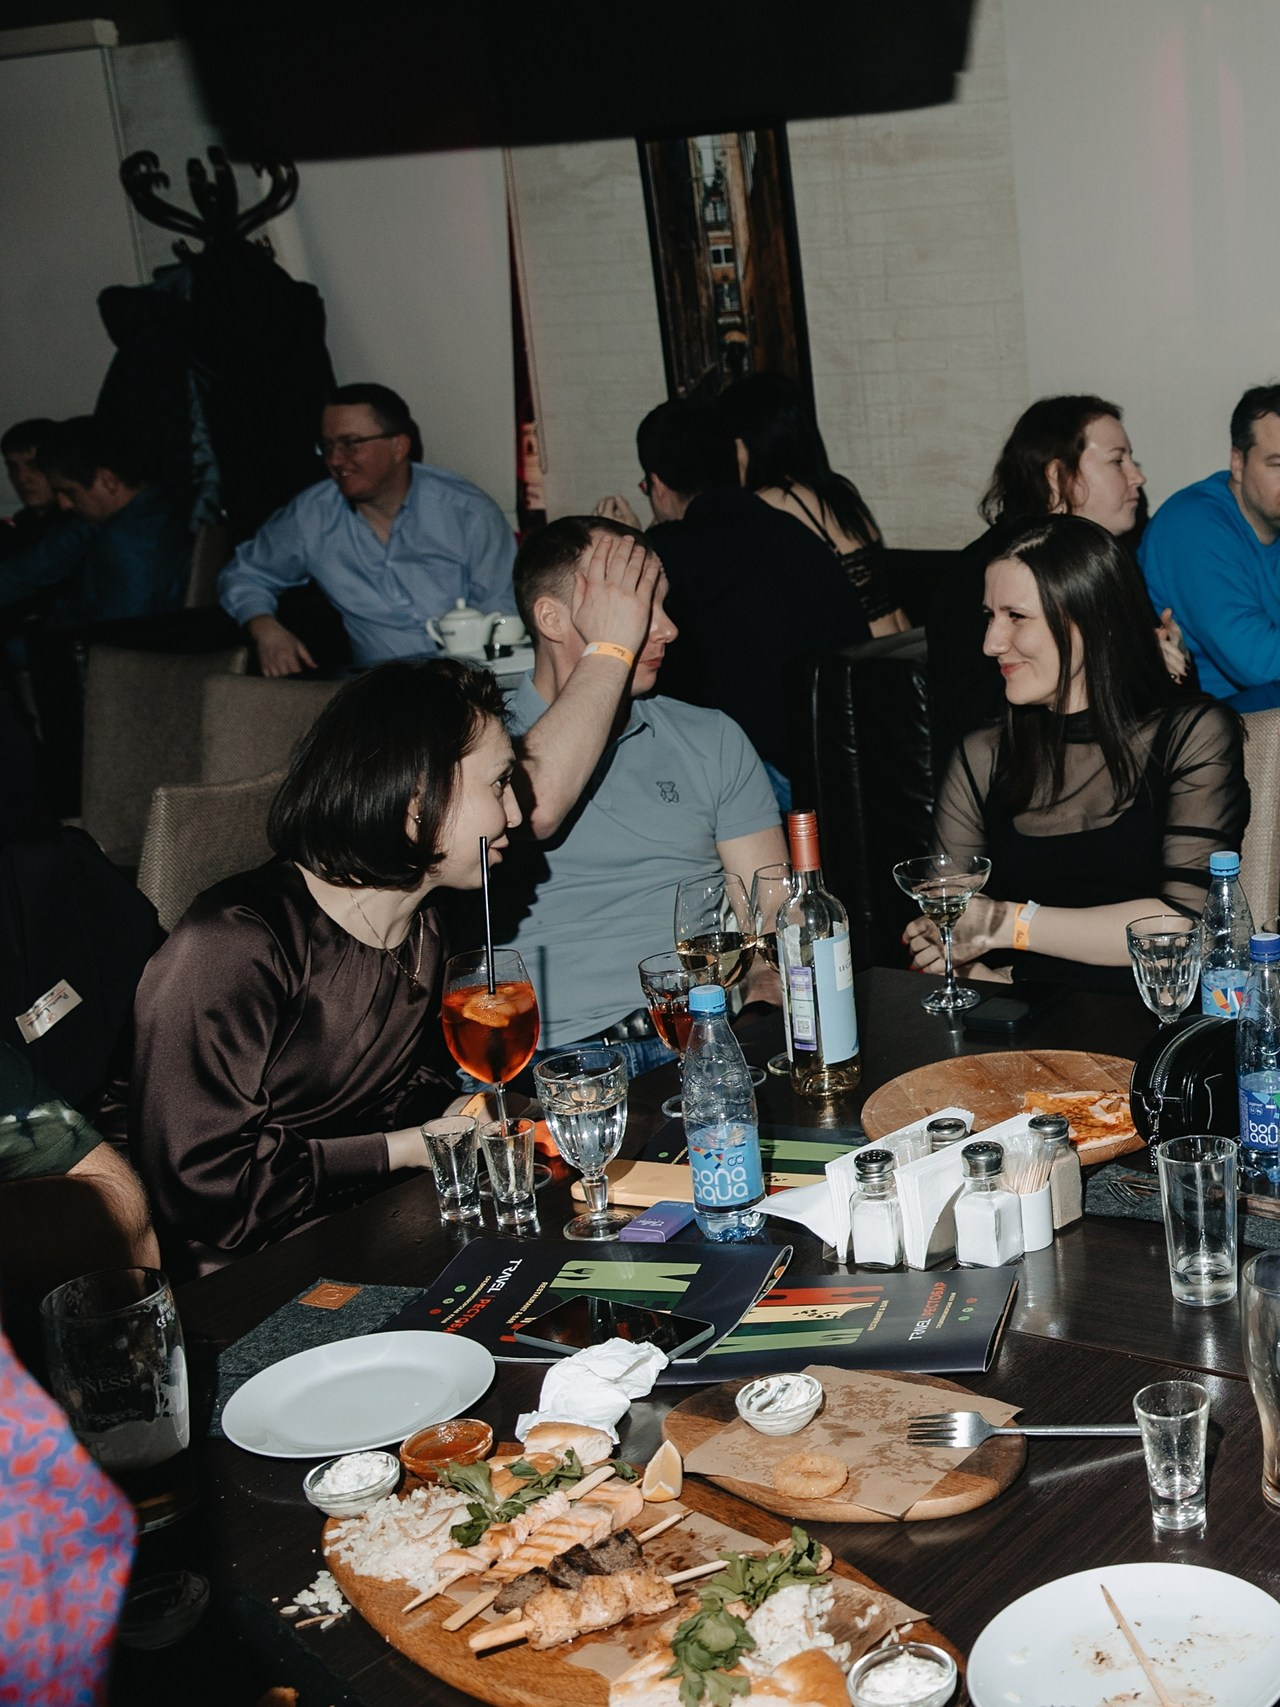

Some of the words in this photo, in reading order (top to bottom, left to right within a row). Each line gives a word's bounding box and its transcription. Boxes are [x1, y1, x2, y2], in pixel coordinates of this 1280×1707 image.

[1250, 1120, 1279, 1134] bon
[1249, 1132, 1279, 1146] aqu
[486, 1258, 523, 1294] TRAVEL
[443, 1298, 493, 1333] РЕСТОБА
[908, 1318, 932, 1341] TRAVEL
